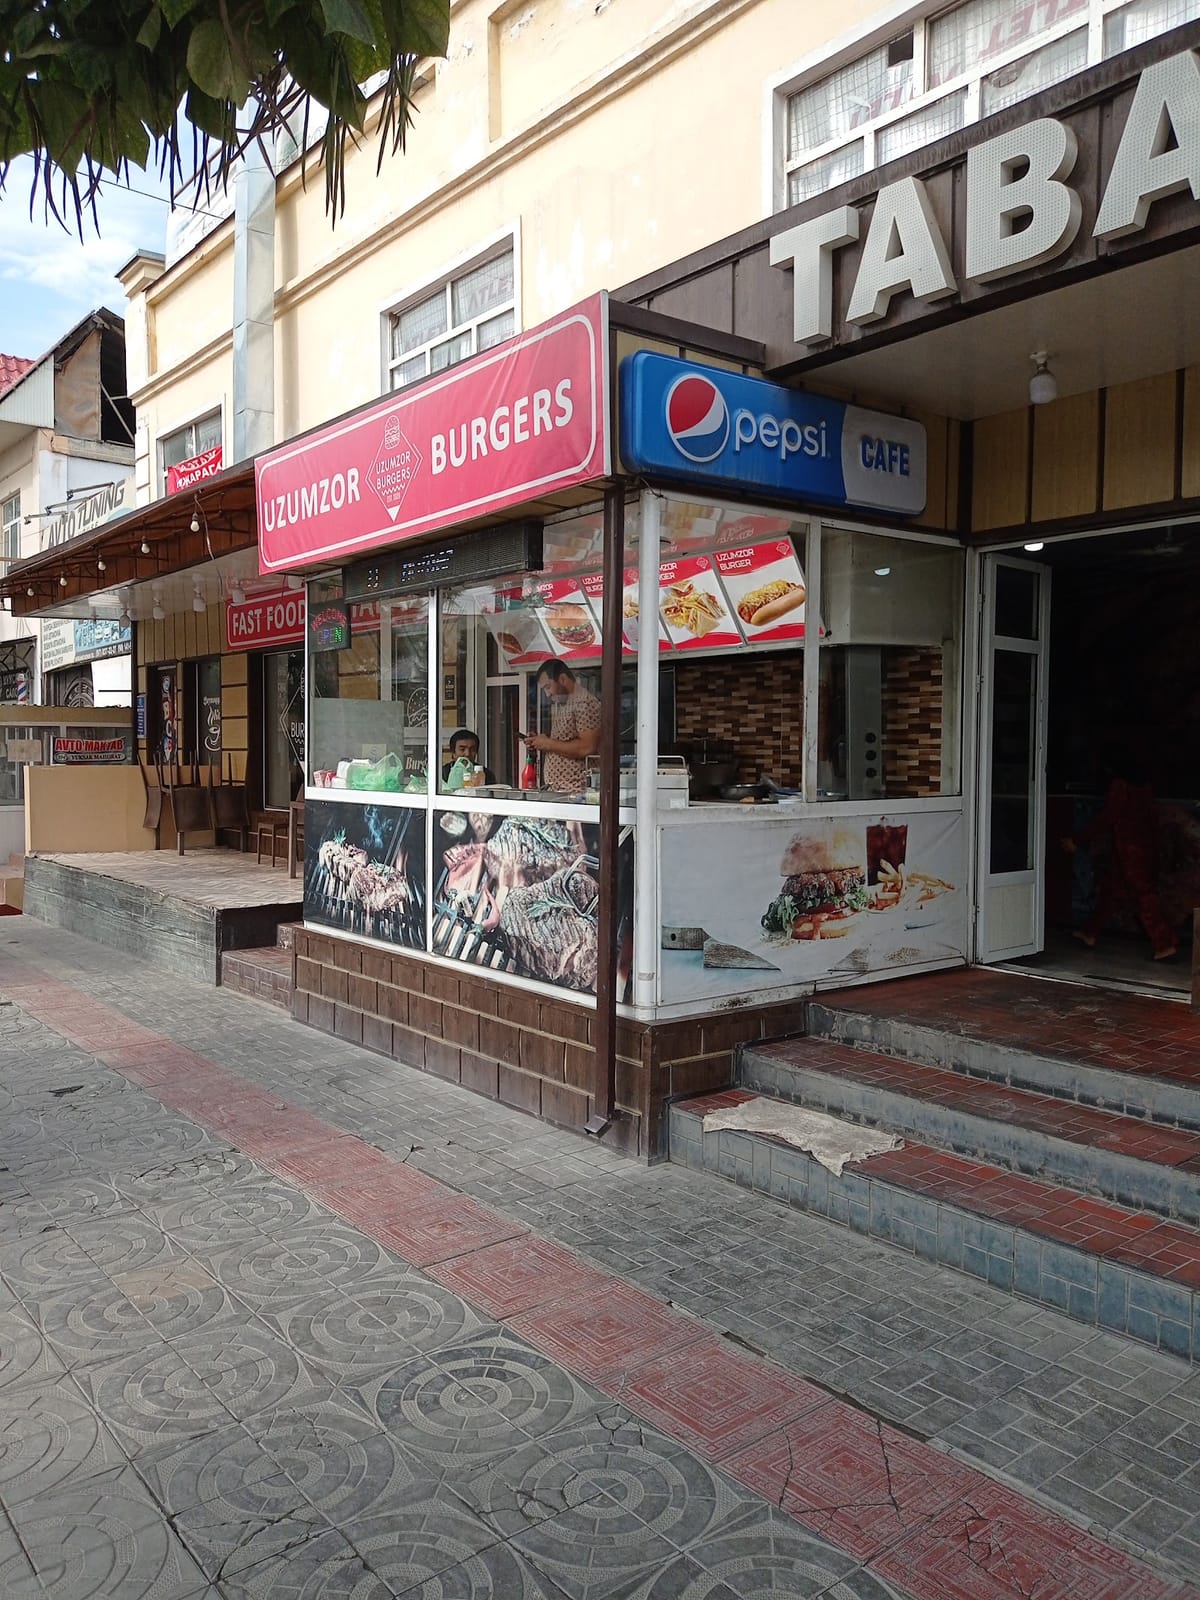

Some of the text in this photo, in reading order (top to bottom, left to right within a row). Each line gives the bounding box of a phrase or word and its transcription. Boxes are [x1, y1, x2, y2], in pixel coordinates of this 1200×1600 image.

[735, 408, 827, 460] pepsi
[264, 379, 574, 533] UZUMZOR BURGERS
[376, 451, 411, 475] UZUMZOR
[861, 434, 910, 476] CAFE
[376, 467, 411, 490] BURGERS
[48, 478, 126, 549] AVTO TUNING
[715, 548, 755, 562] UZUMZOR
[720, 559, 752, 571] BURGER
[232, 599, 305, 637] FAST FOOD
[55, 738, 82, 752] AVTO
